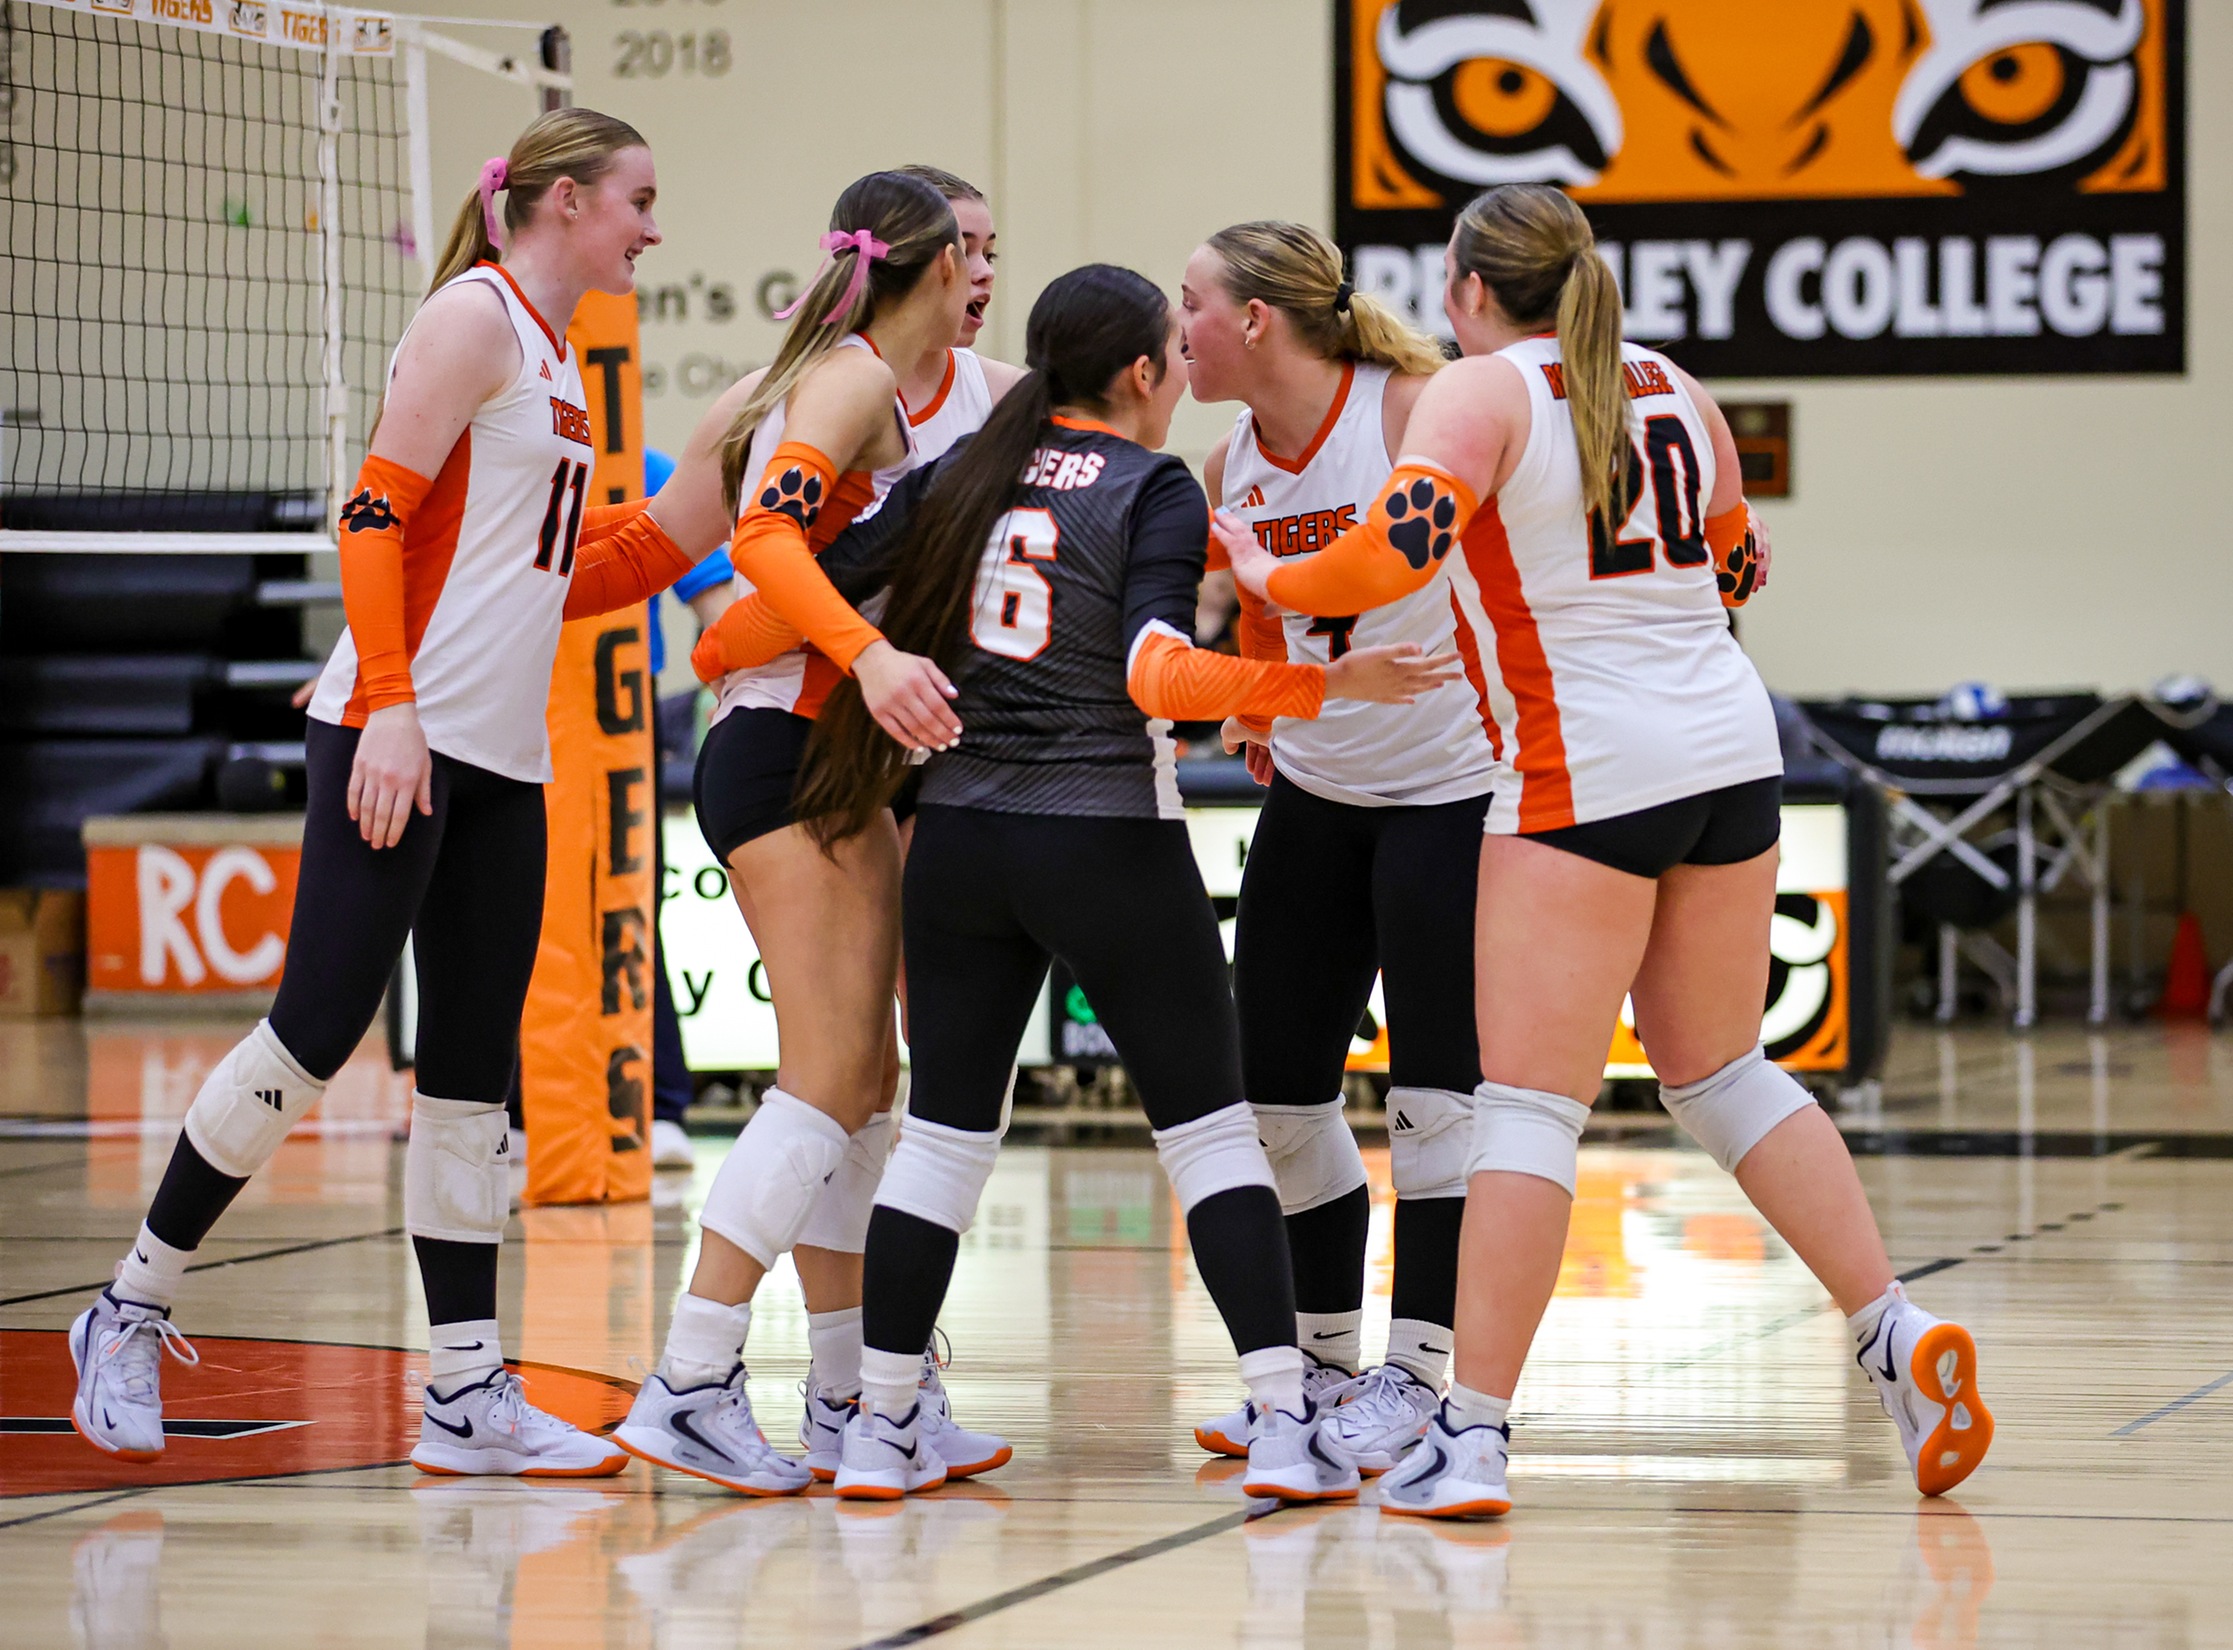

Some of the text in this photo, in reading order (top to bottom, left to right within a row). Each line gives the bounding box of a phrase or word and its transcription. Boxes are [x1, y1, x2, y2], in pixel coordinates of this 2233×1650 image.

[613, 28, 733, 80] 2018
[1764, 233, 2165, 340] COLLEGE
[533, 457, 588, 578] 11
[1587, 413, 1708, 580] 20
[969, 506, 1060, 662] 6
[586, 346, 648, 1154] TGERS
[138, 845, 284, 986] RC
